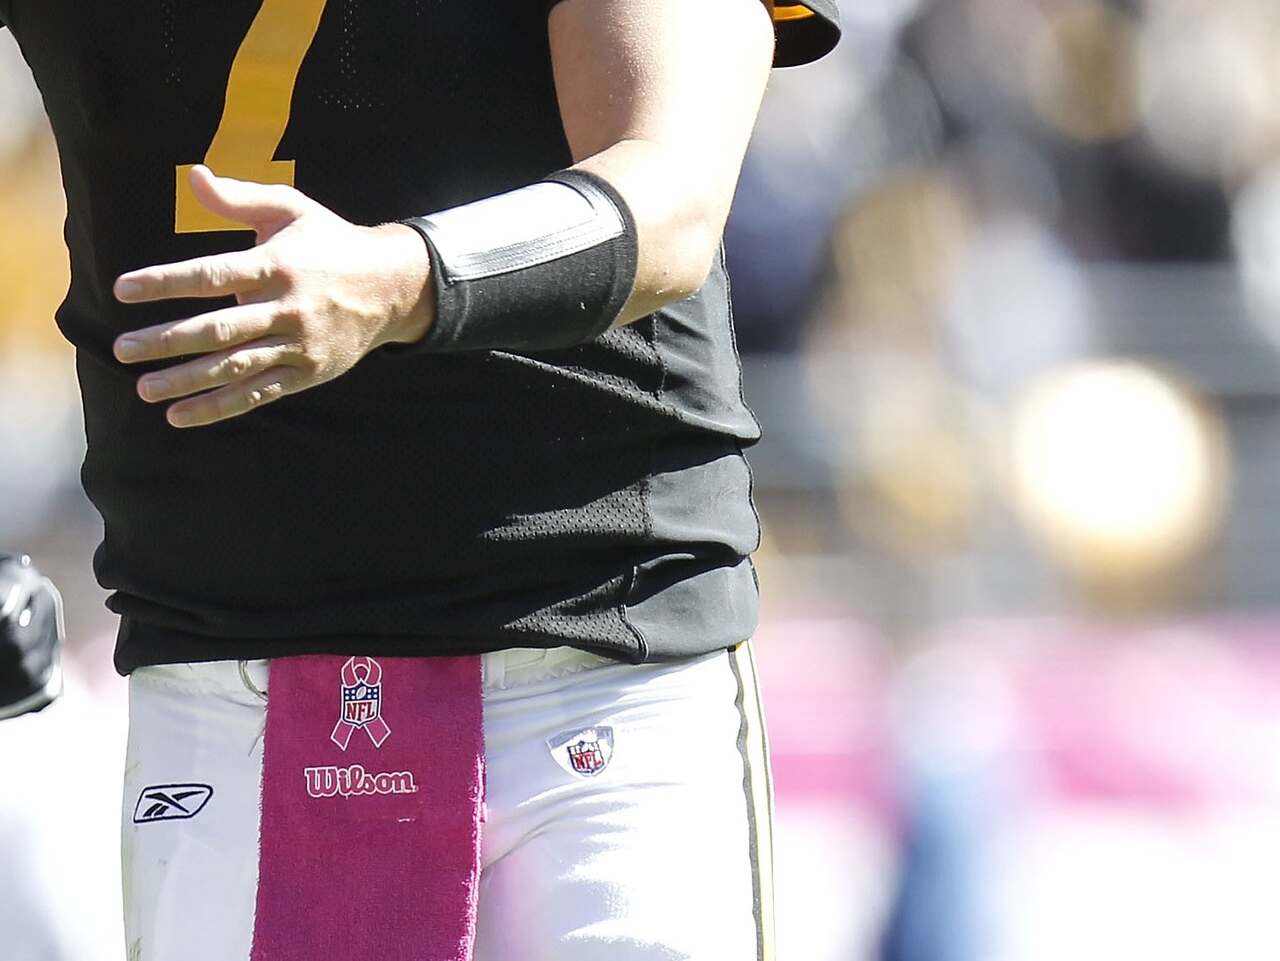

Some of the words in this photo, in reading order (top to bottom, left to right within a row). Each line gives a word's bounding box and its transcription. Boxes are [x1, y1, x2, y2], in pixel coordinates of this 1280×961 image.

[346, 701, 375, 721] NFL
[572, 752, 602, 770] NFL
[304, 764, 415, 799] Wilson
